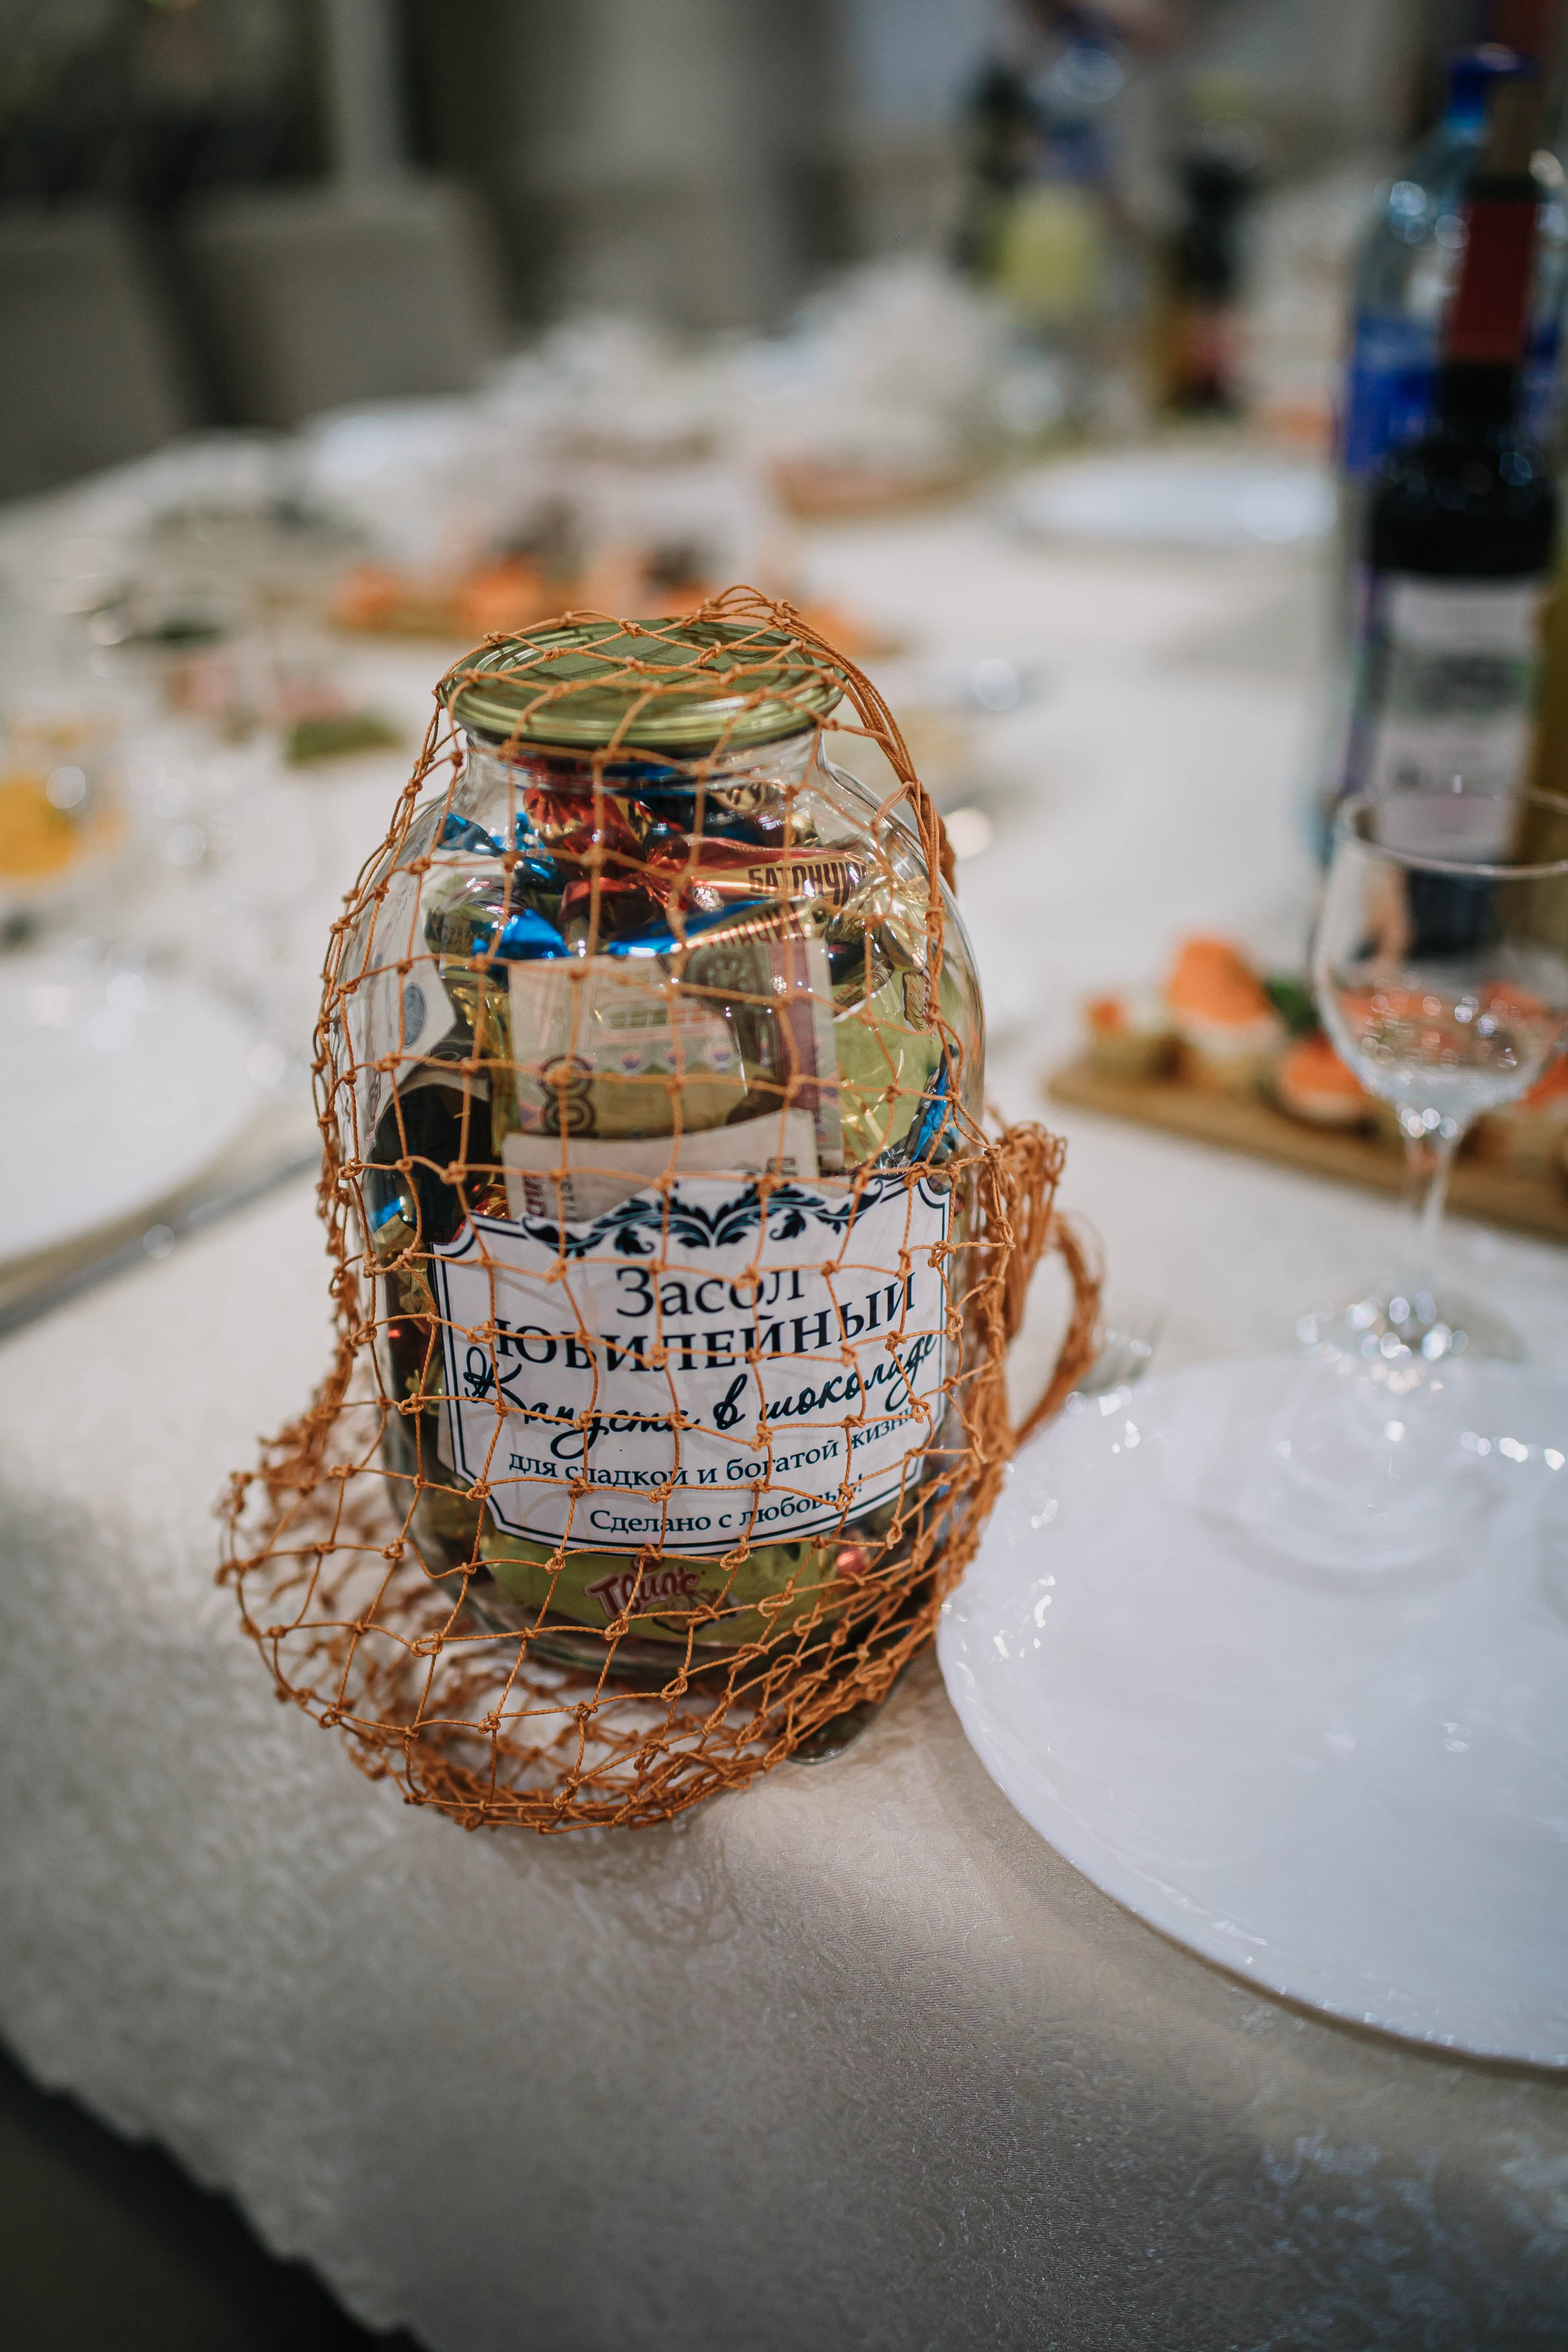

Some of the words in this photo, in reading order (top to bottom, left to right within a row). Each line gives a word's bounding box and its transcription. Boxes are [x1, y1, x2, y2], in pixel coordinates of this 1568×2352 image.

[748, 861, 867, 907] БАТОНЧИ
[616, 1266, 805, 1317] Засол
[494, 1270, 916, 1372] ЮБИЛЕЙНЫЙ
[712, 1373, 747, 1430] в
[759, 1333, 938, 1420] шоколаде
[509, 1453, 558, 1478] для
[565, 1465, 688, 1489] сладкой
[696, 1468, 718, 1485] и
[726, 1439, 839, 1481] богатой
[590, 1509, 712, 1534] Сделано
[718, 1513, 733, 1529] с
